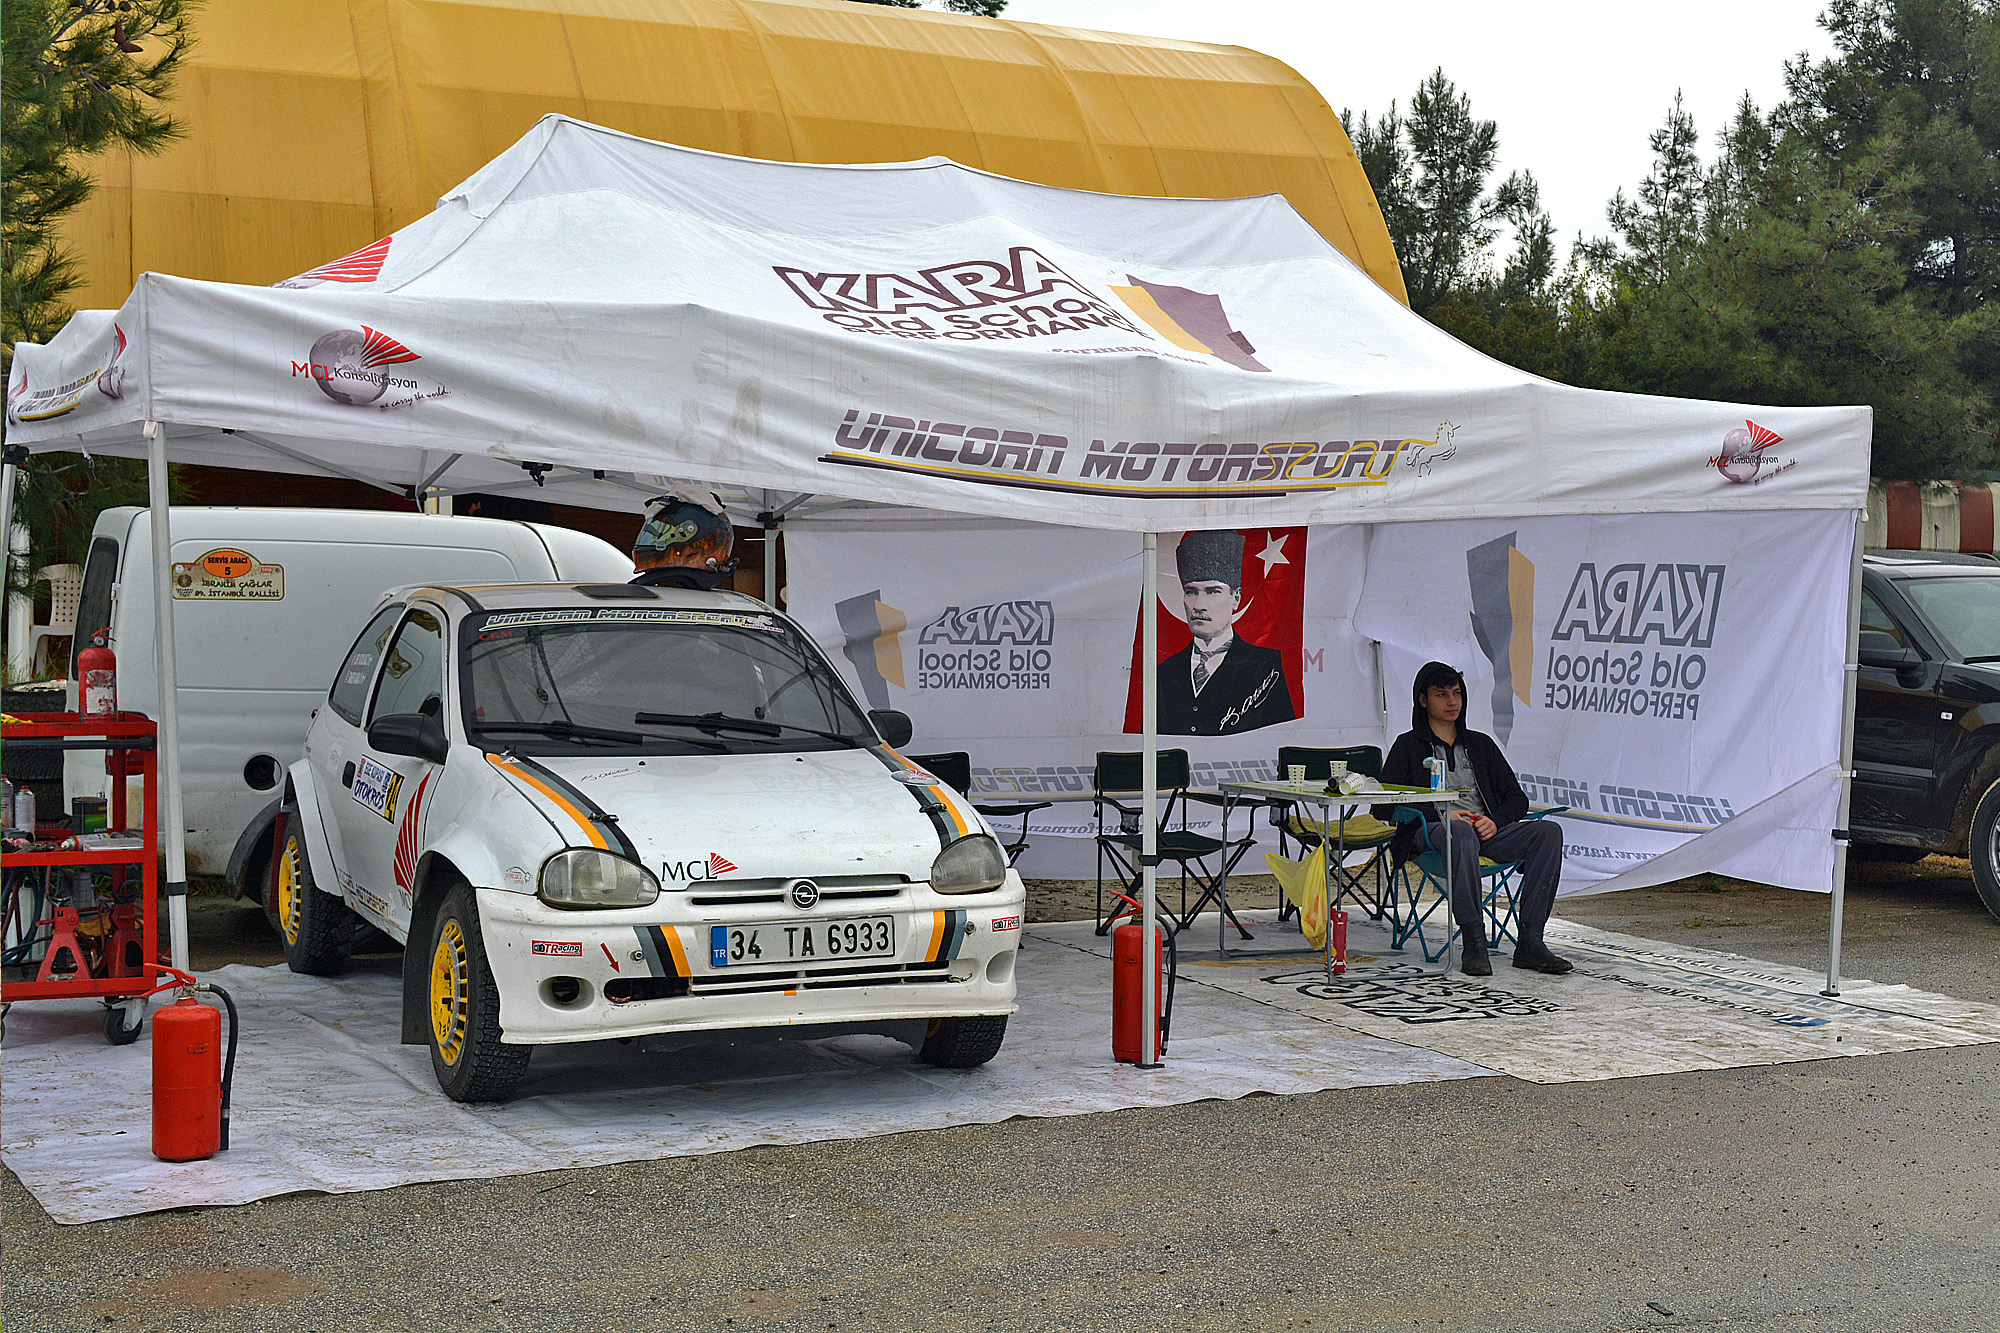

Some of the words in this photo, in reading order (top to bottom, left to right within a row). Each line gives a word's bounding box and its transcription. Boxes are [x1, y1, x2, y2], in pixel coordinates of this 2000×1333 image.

[772, 246, 1111, 314] KARA
[823, 313, 935, 331] Old
[291, 360, 334, 381] MCL
[334, 368, 418, 389] Konsolidasyon
[835, 409, 1069, 475] UNICORN
[1080, 439, 1410, 482] MOTORSPORT
[1706, 456, 1729, 467] MCL
[224, 567, 231, 575] 5
[486, 610, 592, 626] UNICORN
[661, 860, 718, 881] MCL
[714, 949, 726, 958] TR
[730, 930, 762, 960] 34
[784, 927, 813, 957] TA
[828, 921, 890, 953] 6933
